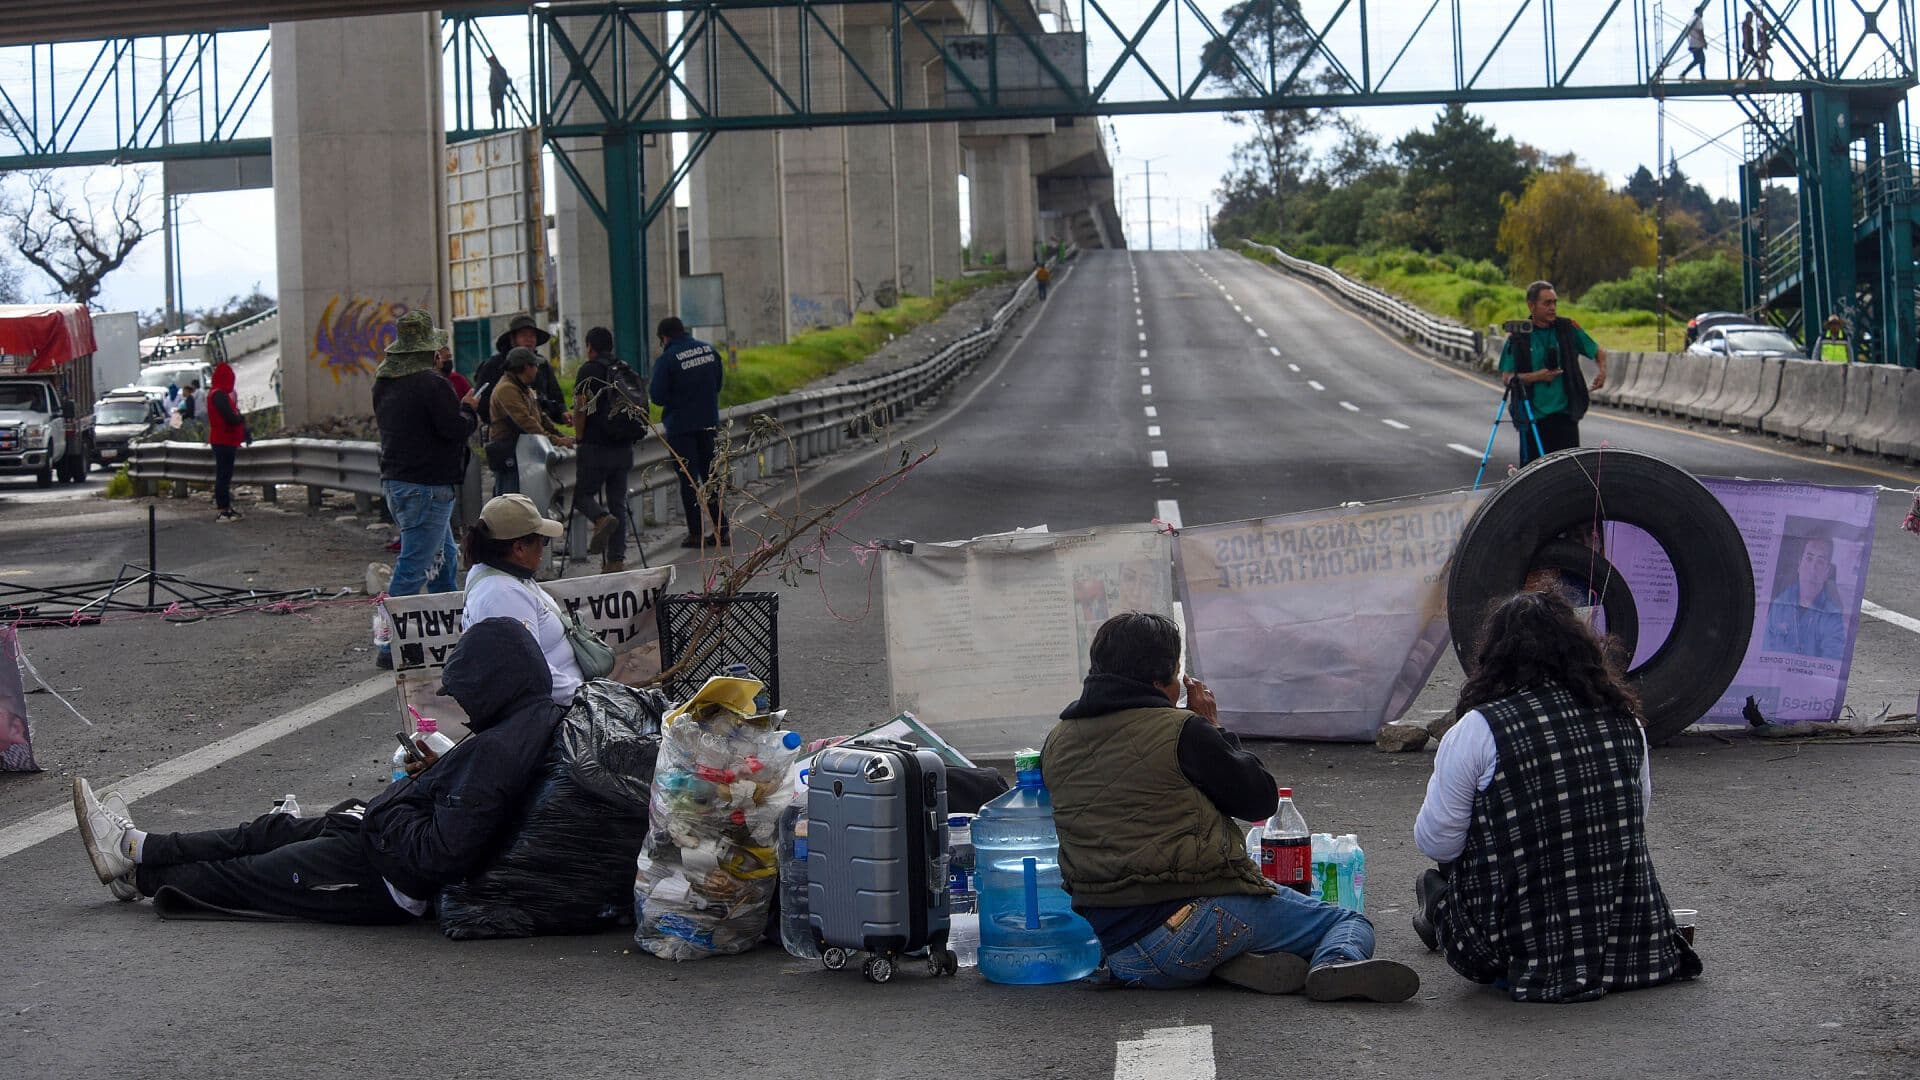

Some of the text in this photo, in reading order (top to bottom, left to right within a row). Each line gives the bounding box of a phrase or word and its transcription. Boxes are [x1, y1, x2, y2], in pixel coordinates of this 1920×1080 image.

[676, 345, 712, 361] UNIDAD DE
[681, 354, 715, 370] GOBIERNO
[588, 587, 662, 621] AYUDA
